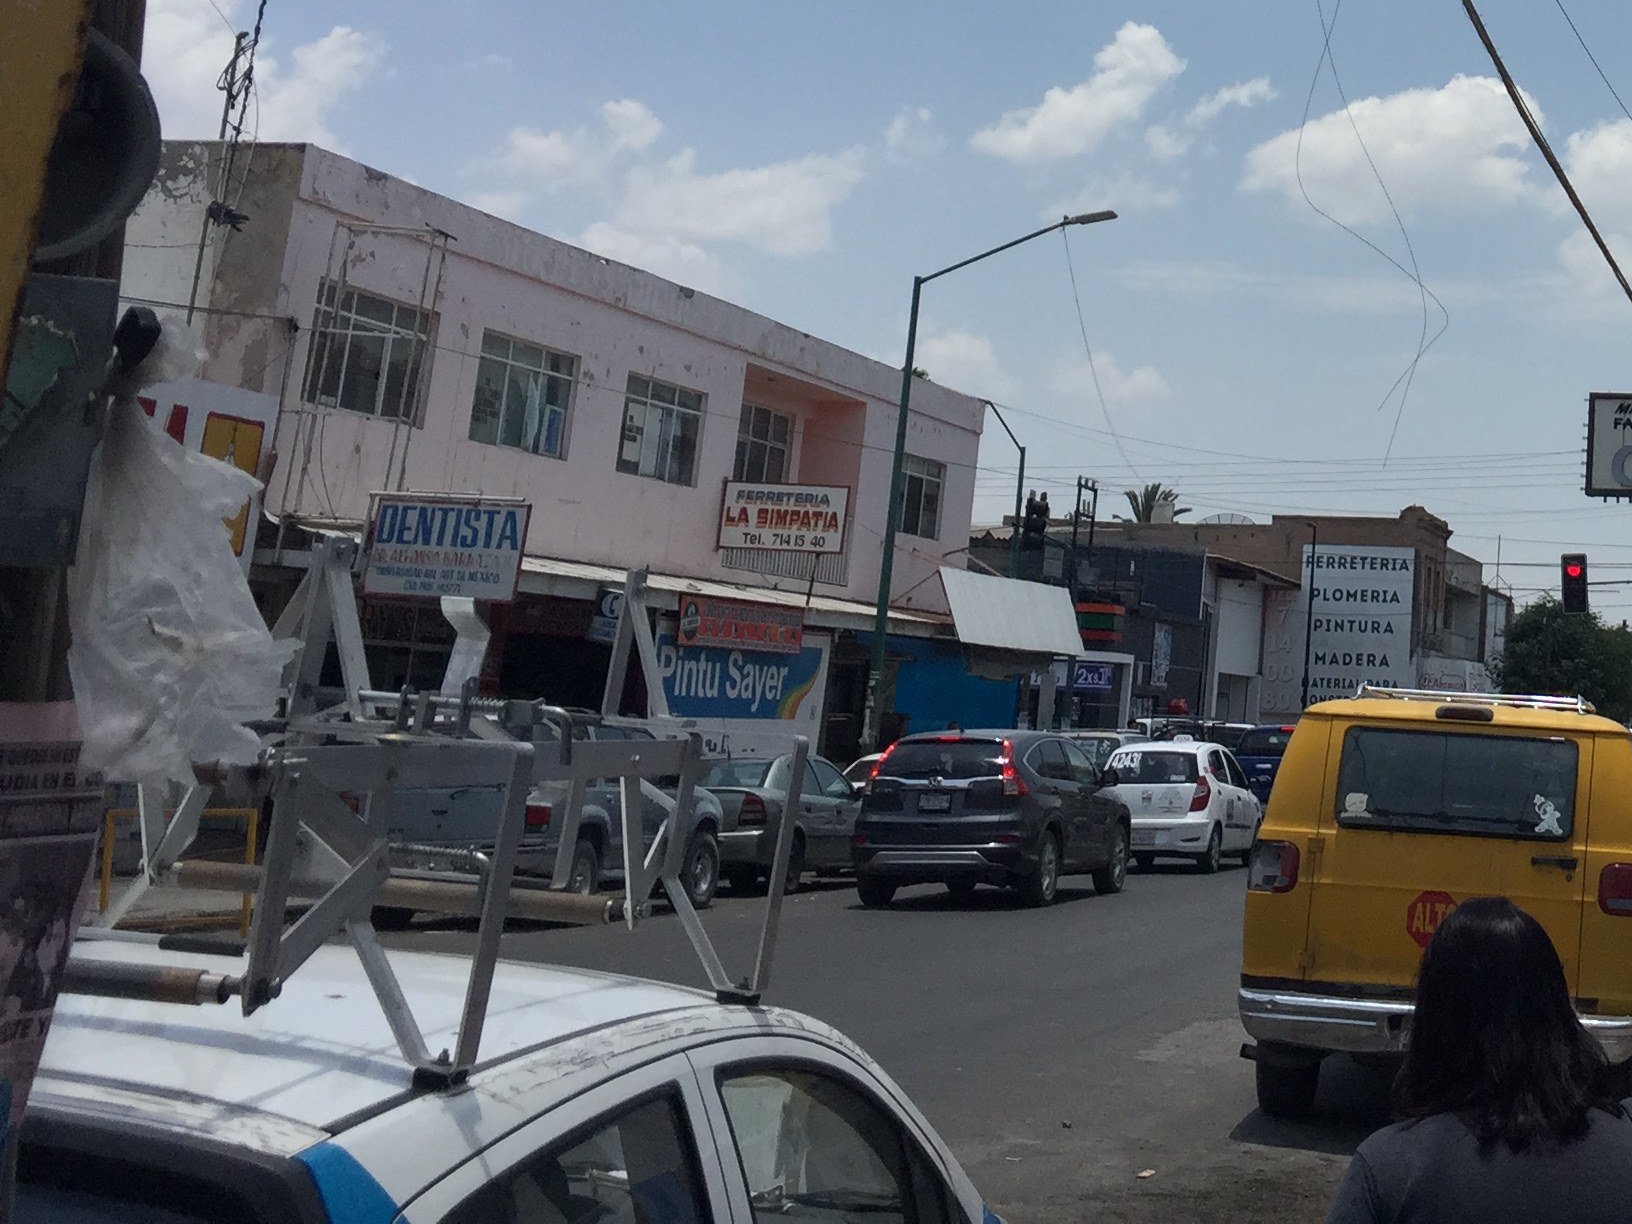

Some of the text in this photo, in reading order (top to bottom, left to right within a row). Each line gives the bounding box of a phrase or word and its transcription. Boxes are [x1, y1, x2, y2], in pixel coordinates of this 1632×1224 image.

[736, 489, 830, 508] FERRETERIA
[376, 504, 519, 550] DENTISTA
[724, 506, 839, 533] LA SIMPATIA
[742, 532, 765, 546] Tel.
[810, 535, 826, 548] 40
[1305, 554, 1410, 572] FERRETERIA
[1311, 587, 1401, 605] PLOMERIA
[1313, 618, 1395, 634] PINTURA
[1314, 651, 1390, 668] MADERA
[659, 644, 789, 713] Pintu Sayer
[1411, 901, 1457, 933] ALT
